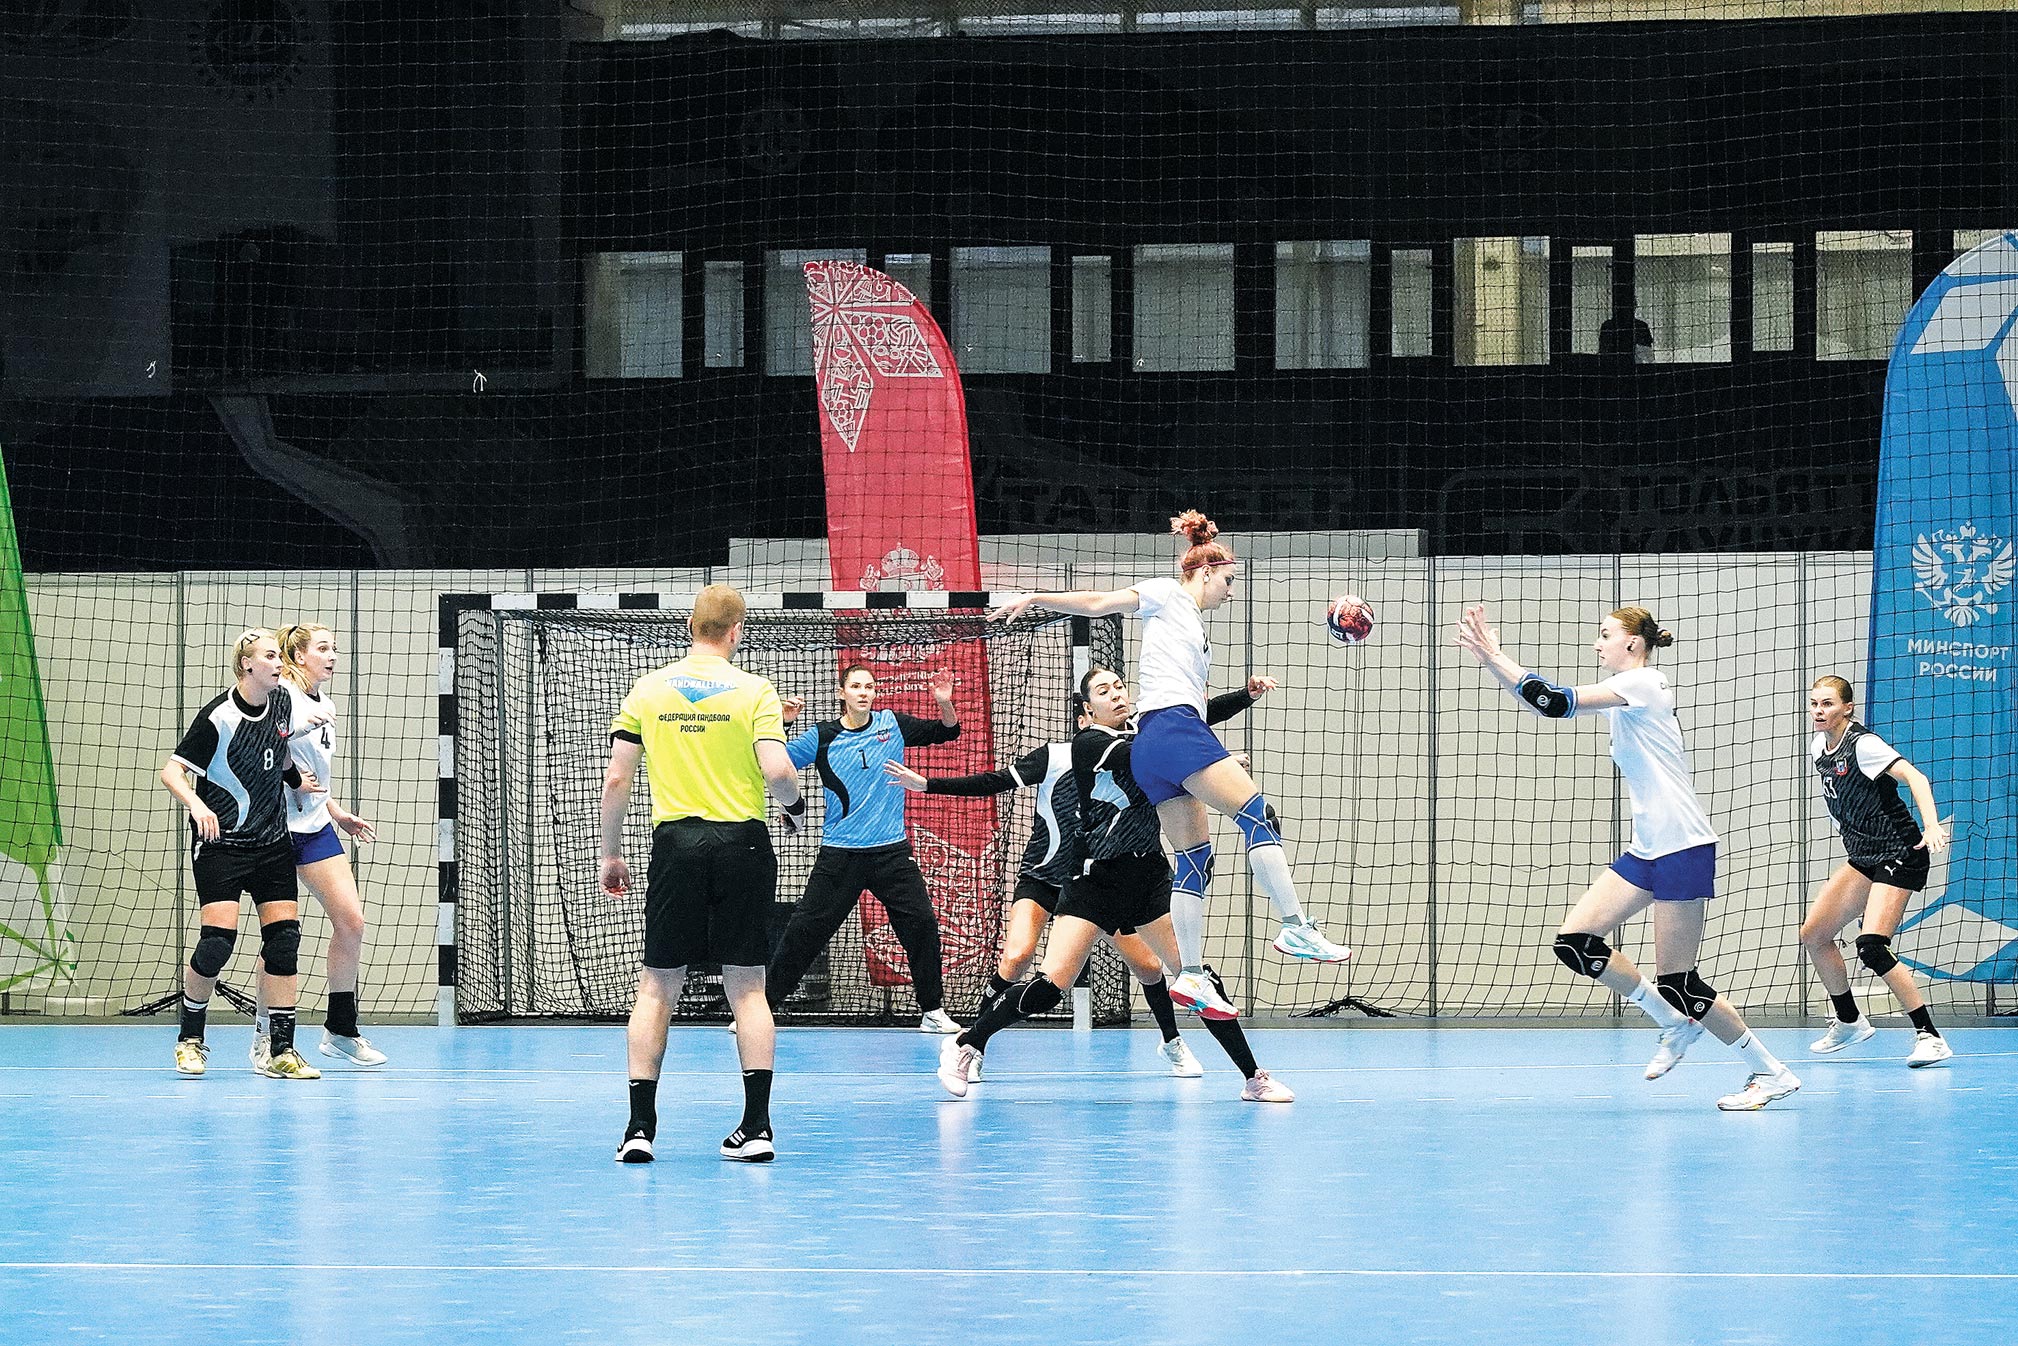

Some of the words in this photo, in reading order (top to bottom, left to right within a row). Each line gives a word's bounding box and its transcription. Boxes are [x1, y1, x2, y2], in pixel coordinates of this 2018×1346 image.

[1621, 475, 1875, 515] ТОЛЬЯТТ
[1907, 638, 2009, 660] МИНСПОРТ
[1919, 661, 1998, 682] РОССИИ
[658, 713, 696, 722] ФЕДЕРАЦИЯ
[697, 713, 731, 722] ГАНДБОЛА
[320, 726, 331, 749] 4
[680, 724, 706, 733] РОССИИ
[263, 748, 274, 770] 8
[859, 749, 869, 770] 1
